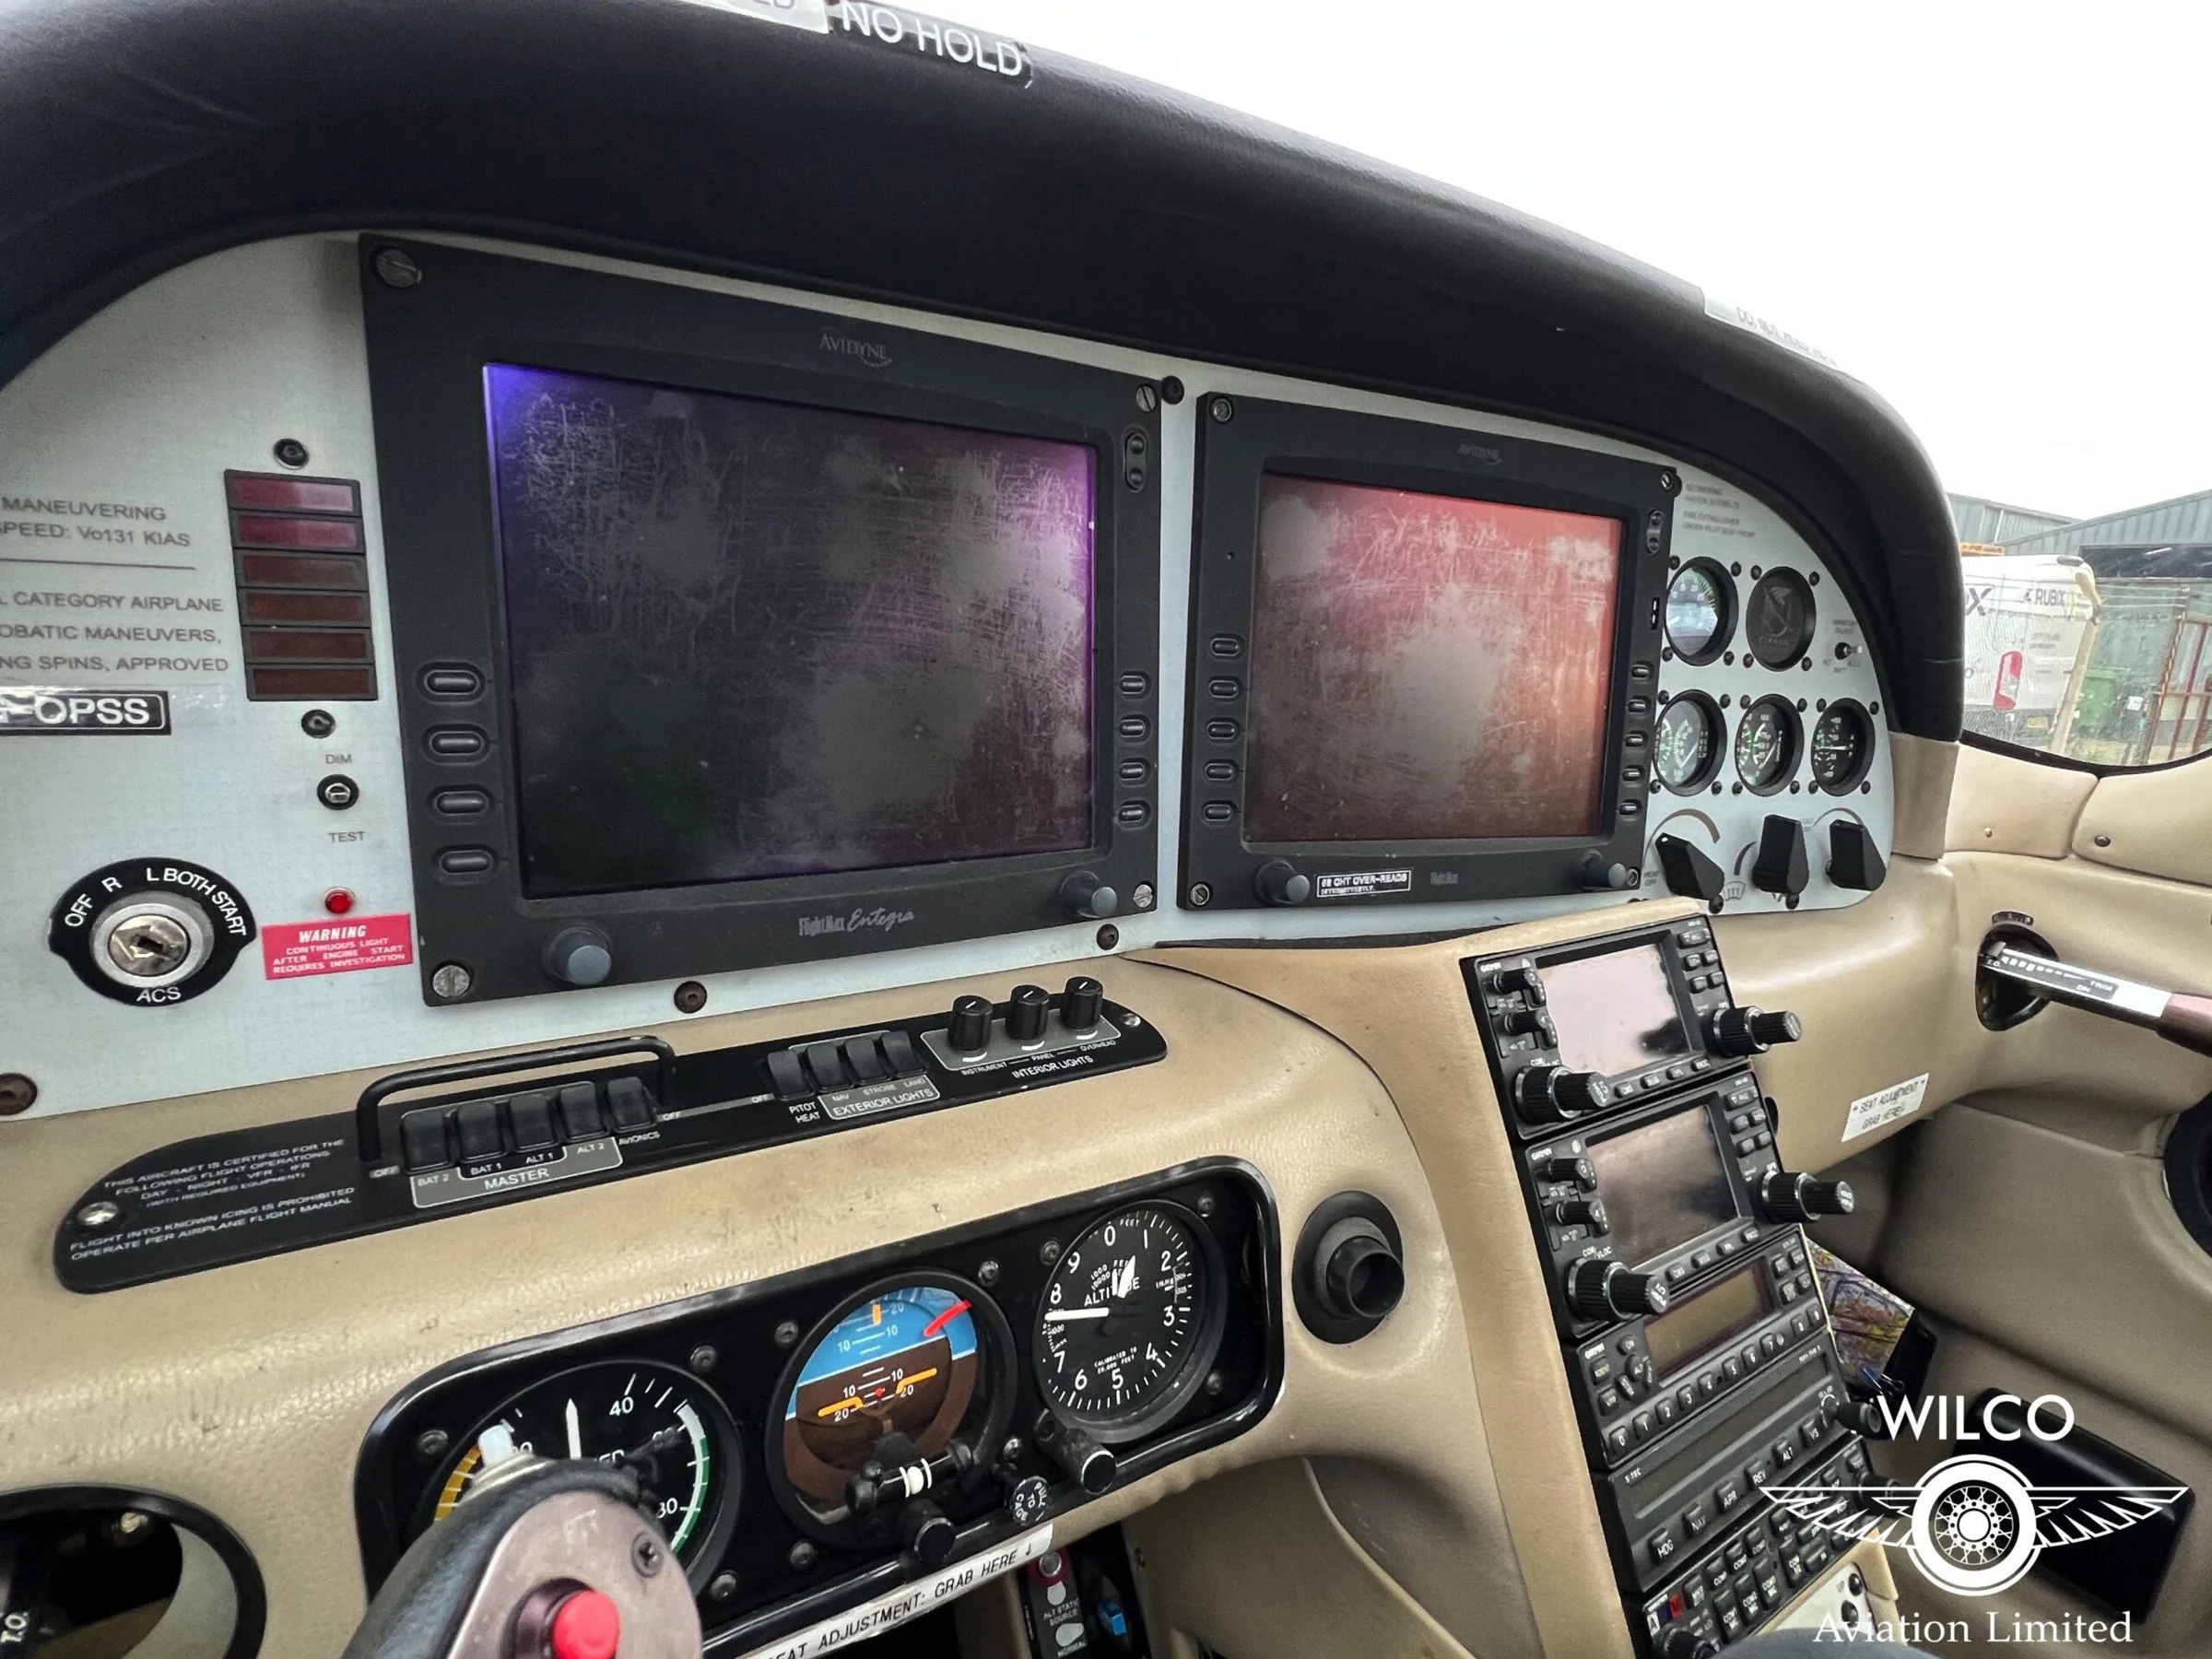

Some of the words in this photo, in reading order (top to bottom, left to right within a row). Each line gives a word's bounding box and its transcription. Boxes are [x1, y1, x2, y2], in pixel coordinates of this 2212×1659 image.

[841, 2, 902, 43] NO
[915, 18, 1023, 76] HOLD
[818, 332, 888, 360] AVIDYNE
[1, 496, 167, 521] MANEUVERING
[144, 530, 192, 547] KIAS
[13, 591, 124, 609] CATEGORY
[131, 595, 224, 612] AIRPLANE
[85, 626, 222, 644] MANEUVERS,
[39, 655, 110, 672] SPINS,
[116, 656, 229, 673] APPROVED
[325, 753, 353, 765] DIM
[328, 830, 366, 842] TEST
[101, 876, 123, 893] R
[146, 867, 159, 882] L
[163, 867, 217, 896] BOTH
[65, 893, 93, 927] OFF
[211, 890, 247, 936] START
[847, 905, 915, 932] Entegra
[299, 924, 367, 944] WARNING
[273, 955, 307, 966] AFTER
[323, 949, 359, 960] ENGINE
[371, 945, 404, 955] START
[286, 942, 356, 956] CONTINUOUS
[359, 937, 390, 947] LIGHT
[273, 961, 325, 974] REQUIRES
[330, 953, 406, 968] INVESTIGATION
[136, 986, 182, 1003] ACS
[961, 1061, 1008, 1077] INSTRUMENT
[1030, 1053, 1055, 1062] PANEL
[1080, 1040, 1117, 1053] OVERHEAD
[1011, 1062, 1059, 1079] INTERIOR
[1059, 1054, 1095, 1070] LIGHTS
[789, 1100, 818, 1115] PITOT
[832, 1097, 893, 1117] EXTERIOR
[894, 1087, 935, 1104] LIGHTS
[663, 1111, 682, 1122] OFF
[795, 1112, 822, 1124] HEAT
[577, 1144, 596, 1155] ALT
[598, 1142, 606, 1150] 2
[618, 1131, 662, 1146] AVIONICS
[104, 1177, 135, 1189] THIS
[137, 1164, 205, 1182] AIRCRAFT
[223, 1148, 290, 1167] CERTIFIED
[292, 1144, 319, 1154] FOR
[323, 1138, 345, 1148] THE
[525, 1153, 546, 1164] ALT
[115, 1174, 198, 1195] FOLLOWING
[200, 1165, 247, 1179] FLIGHT
[250, 1150, 331, 1171] OPERATIONS
[418, 1174, 441, 1187] BAT
[441, 1172, 451, 1182] 2
[471, 1165, 494, 1176] BAT
[484, 1167, 550, 1191] MASTER
[141, 1189, 169, 1200] DAY
[187, 1177, 229, 1191] NIGHT
[247, 1169, 274, 1180] VFR
[70, 1233, 124, 1252] FLIGHT
[127, 1226, 161, 1239] INTO
[164, 1216, 218, 1231] KNOWN
[221, 1206, 259, 1219] ICING
[262, 1203, 276, 1211] IS
[277, 1187, 355, 1208] PROHIBITED
[71, 1239, 141, 1261] OPERATE
[145, 1232, 176, 1246] PER
[178, 1218, 246, 1239] AIRPLANE
[250, 1207, 297, 1224] FLIGHT
[300, 1197, 353, 1213] MANUAL
[1103, 1225, 1116, 1246] 0
[1120, 1218, 1140, 1228] FEET
[1143, 1229, 1148, 1250] 1
[1067, 1251, 1081, 1275] 9
[1160, 1250, 1171, 1272] 2
[1050, 1283, 1062, 1304] 8
[1084, 1277, 1141, 1307] ALTIE
[890, 1301, 905, 1315] 20
[1163, 1305, 1175, 1327] 3
[886, 1324, 899, 1338] 10
[838, 1339, 852, 1354] 10
[1146, 1342, 1158, 1361] 4
[1053, 1350, 1065, 1373] 7
[891, 1368, 904, 1382] 10
[1075, 1368, 1088, 1391] 6
[1112, 1368, 1124, 1390] 5
[843, 1384, 857, 1398] 10
[900, 1384, 914, 1399] 20
[608, 1395, 635, 1418] 40
[834, 1407, 850, 1422] 20
[1027, 1492, 1036, 1510] TO
[1033, 1481, 1048, 1509] PULL
[1014, 1493, 1029, 1521] CAGE
[818, 1591, 925, 1651] ADJUSTMENT:
[934, 1570, 974, 1599] GRAB
[981, 1549, 1018, 1578] HERE
[1049, 1607, 1078, 1627] SOURCE
